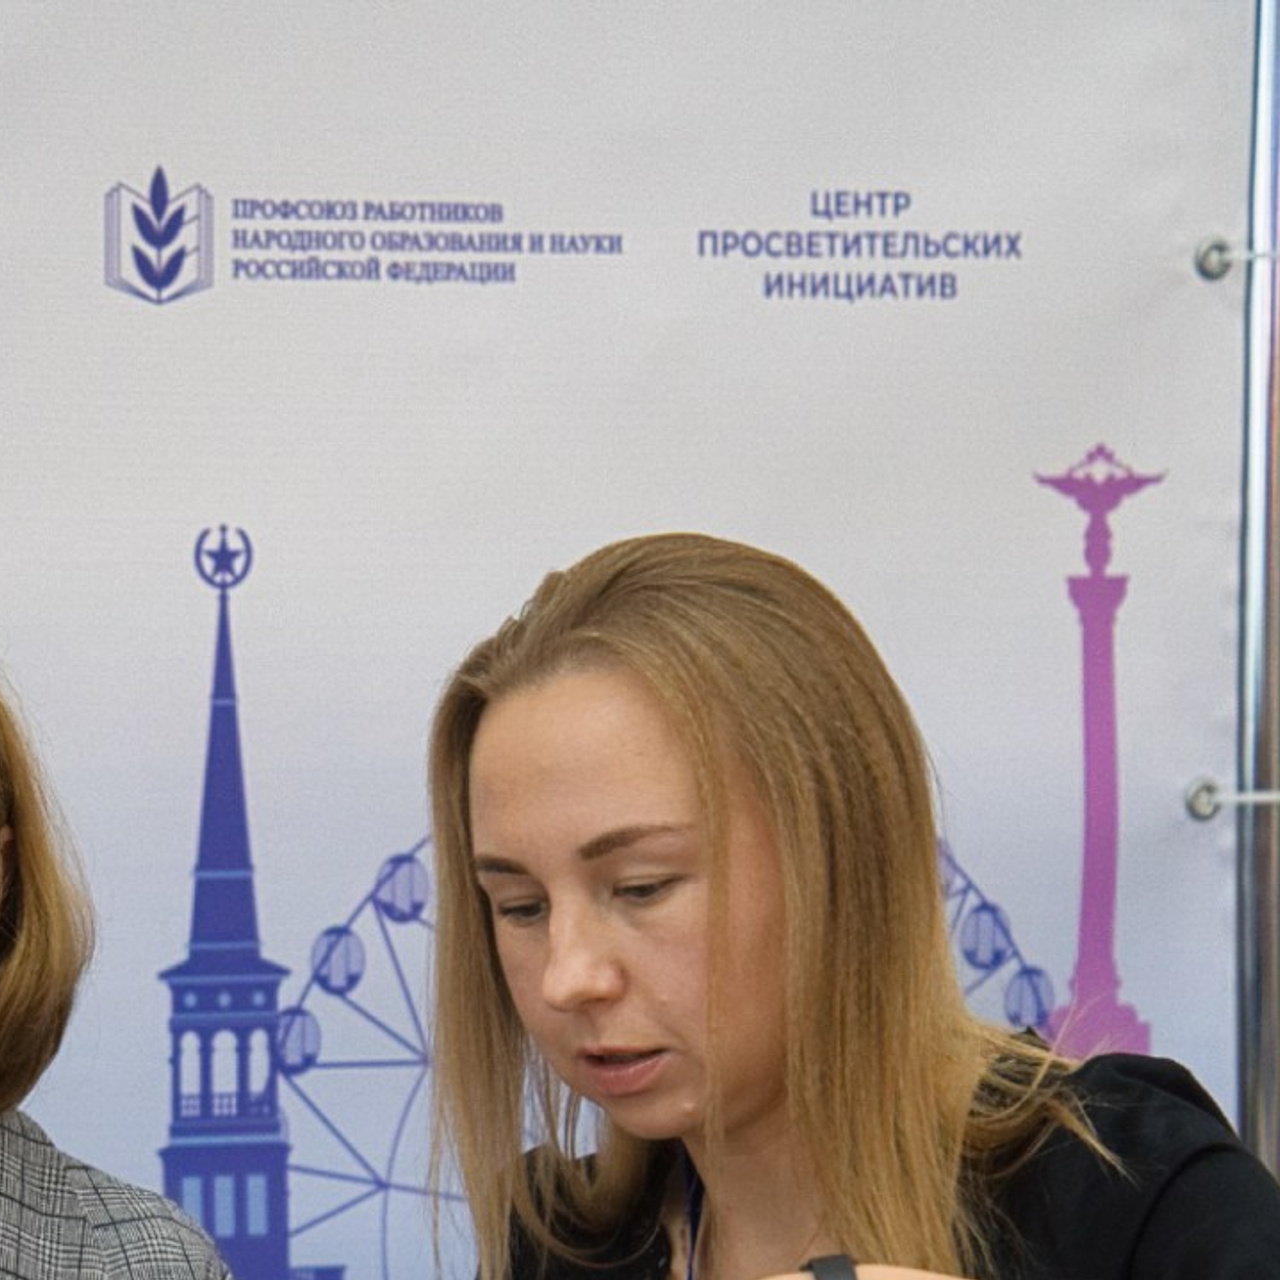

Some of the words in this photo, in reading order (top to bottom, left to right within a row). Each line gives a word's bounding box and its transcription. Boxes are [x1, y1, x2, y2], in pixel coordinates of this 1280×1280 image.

[232, 199, 358, 222] ПРОФСОЮЗ
[363, 200, 504, 223] РАБОТНИКОВ
[810, 190, 912, 221] ЦЕНТР
[232, 229, 365, 252] НАРОДНОГО
[370, 231, 522, 254] ОБРАЗОВАНИЯ
[529, 234, 545, 254] И
[549, 234, 624, 255] НАУКИ
[697, 230, 1022, 259] ПРОСВЕТИТЕЛЬСКИХ
[232, 257, 381, 281] РОССИЙСКОЙ
[387, 261, 516, 284] ФЕДЕРАЦИИ
[763, 271, 958, 303] ИНИЦИАТИВ
